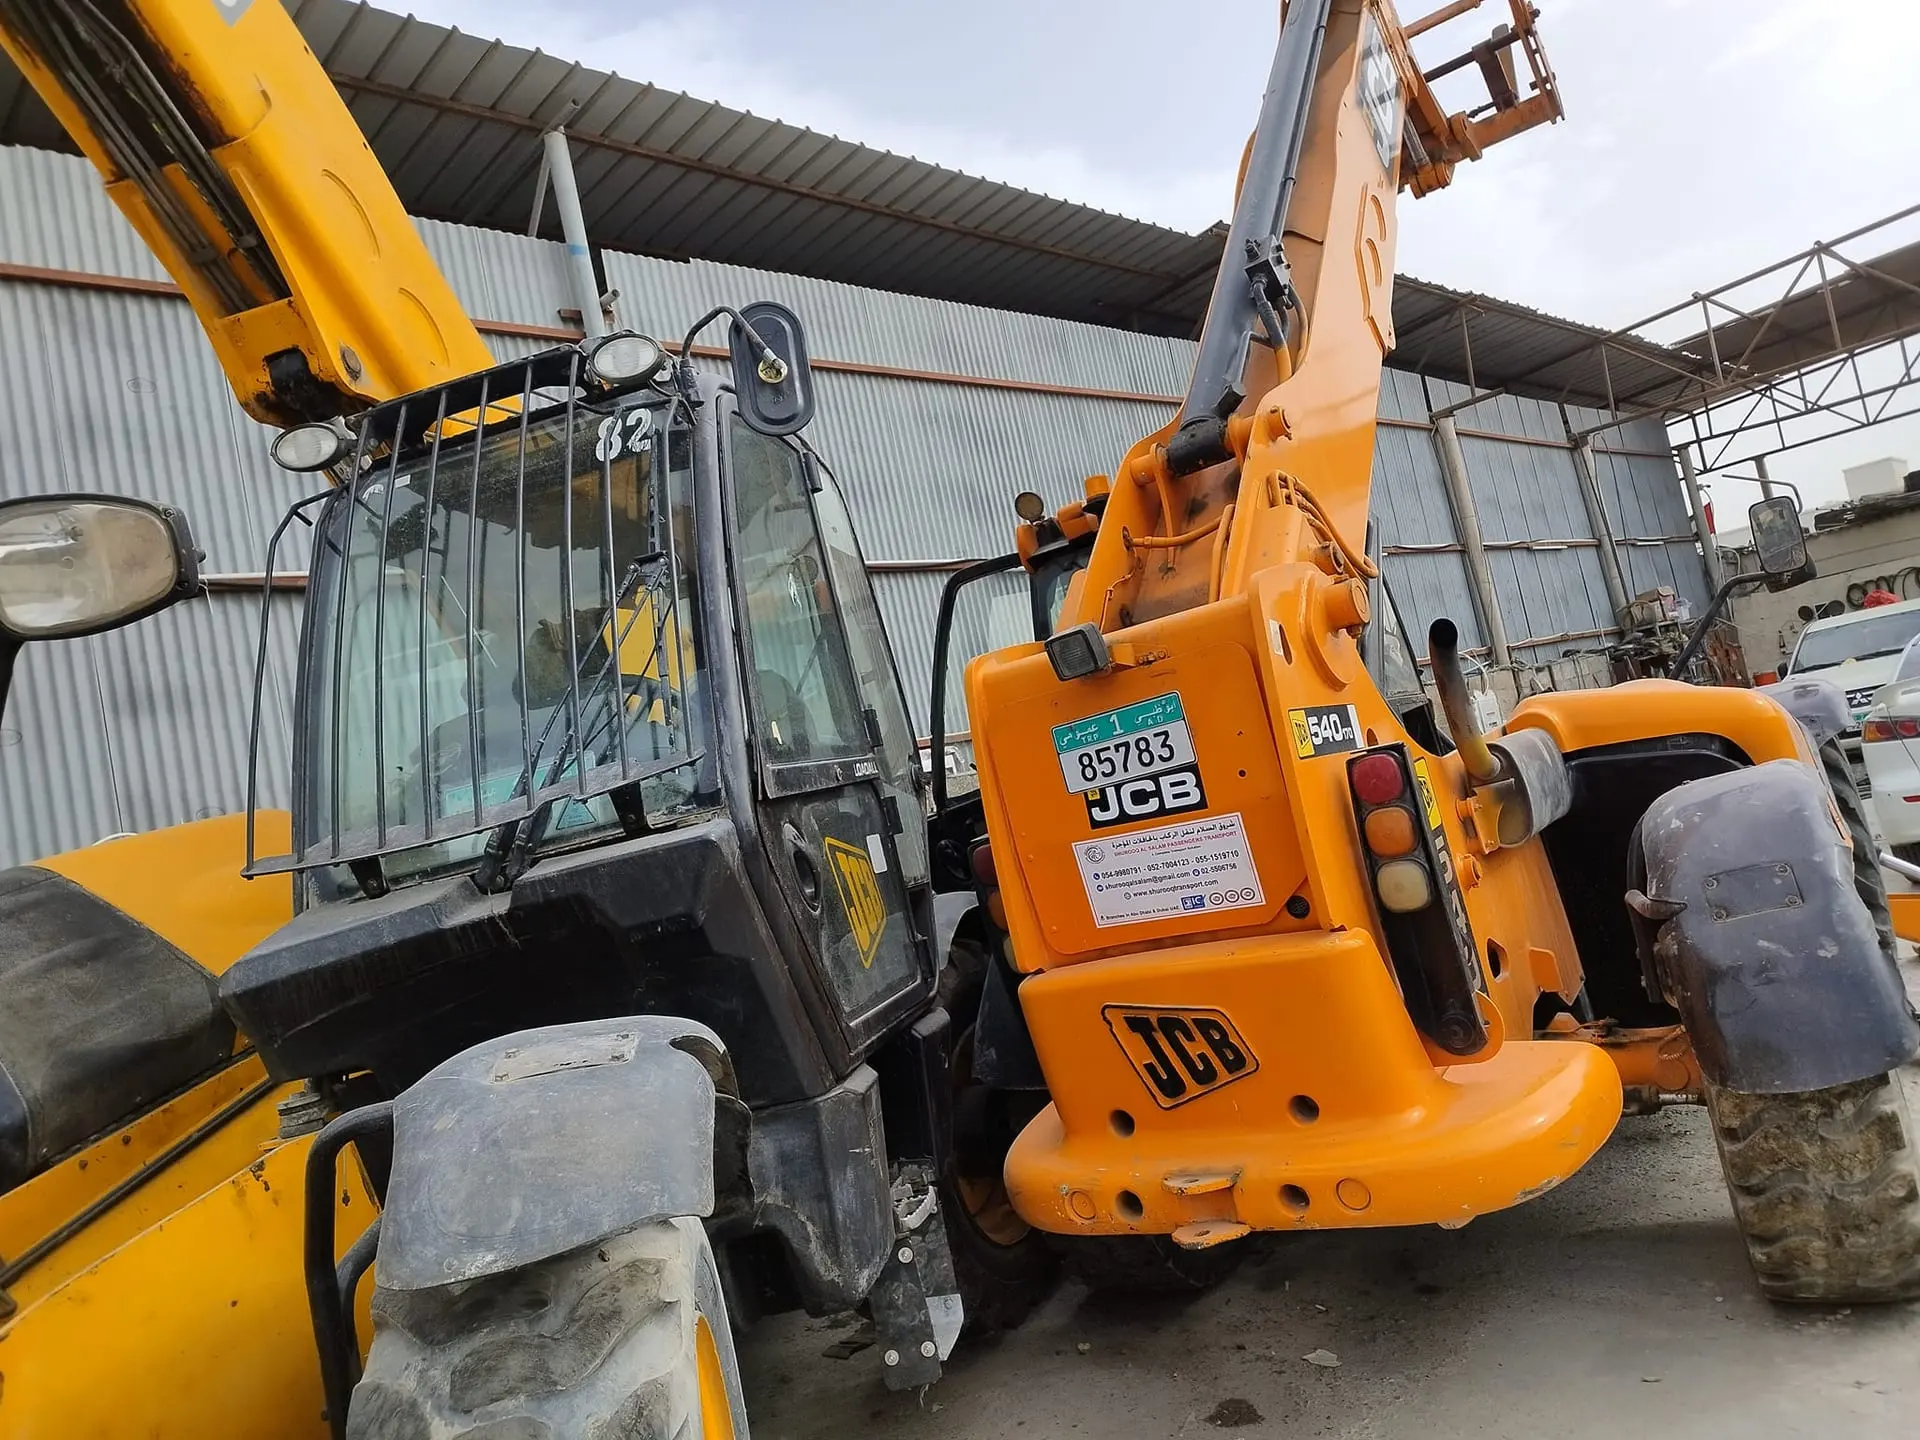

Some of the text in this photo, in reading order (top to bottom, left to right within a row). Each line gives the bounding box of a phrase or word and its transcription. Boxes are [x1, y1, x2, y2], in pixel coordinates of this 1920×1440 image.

[595, 408, 652, 461] 82
[1109, 714, 1124, 735] 1
[1307, 713, 1343, 745] 540
[853, 761, 879, 777] LOADALL
[1078, 729, 1175, 782] 85783
[1091, 772, 1201, 821] JCB
[1159, 831, 1179, 841] الركاب
[1196, 823, 1217, 834] السلام
[1148, 843, 1166, 852] SALAM
[1101, 866, 1142, 879] 054-9980791
[1147, 858, 1190, 872] 052-7004123
[1195, 850, 1239, 864] 055-1519710
[836, 851, 884, 951] JCB
[1133, 879, 1219, 897] www.shurooqtransport.com
[1123, 1013, 1247, 1099] JCB
